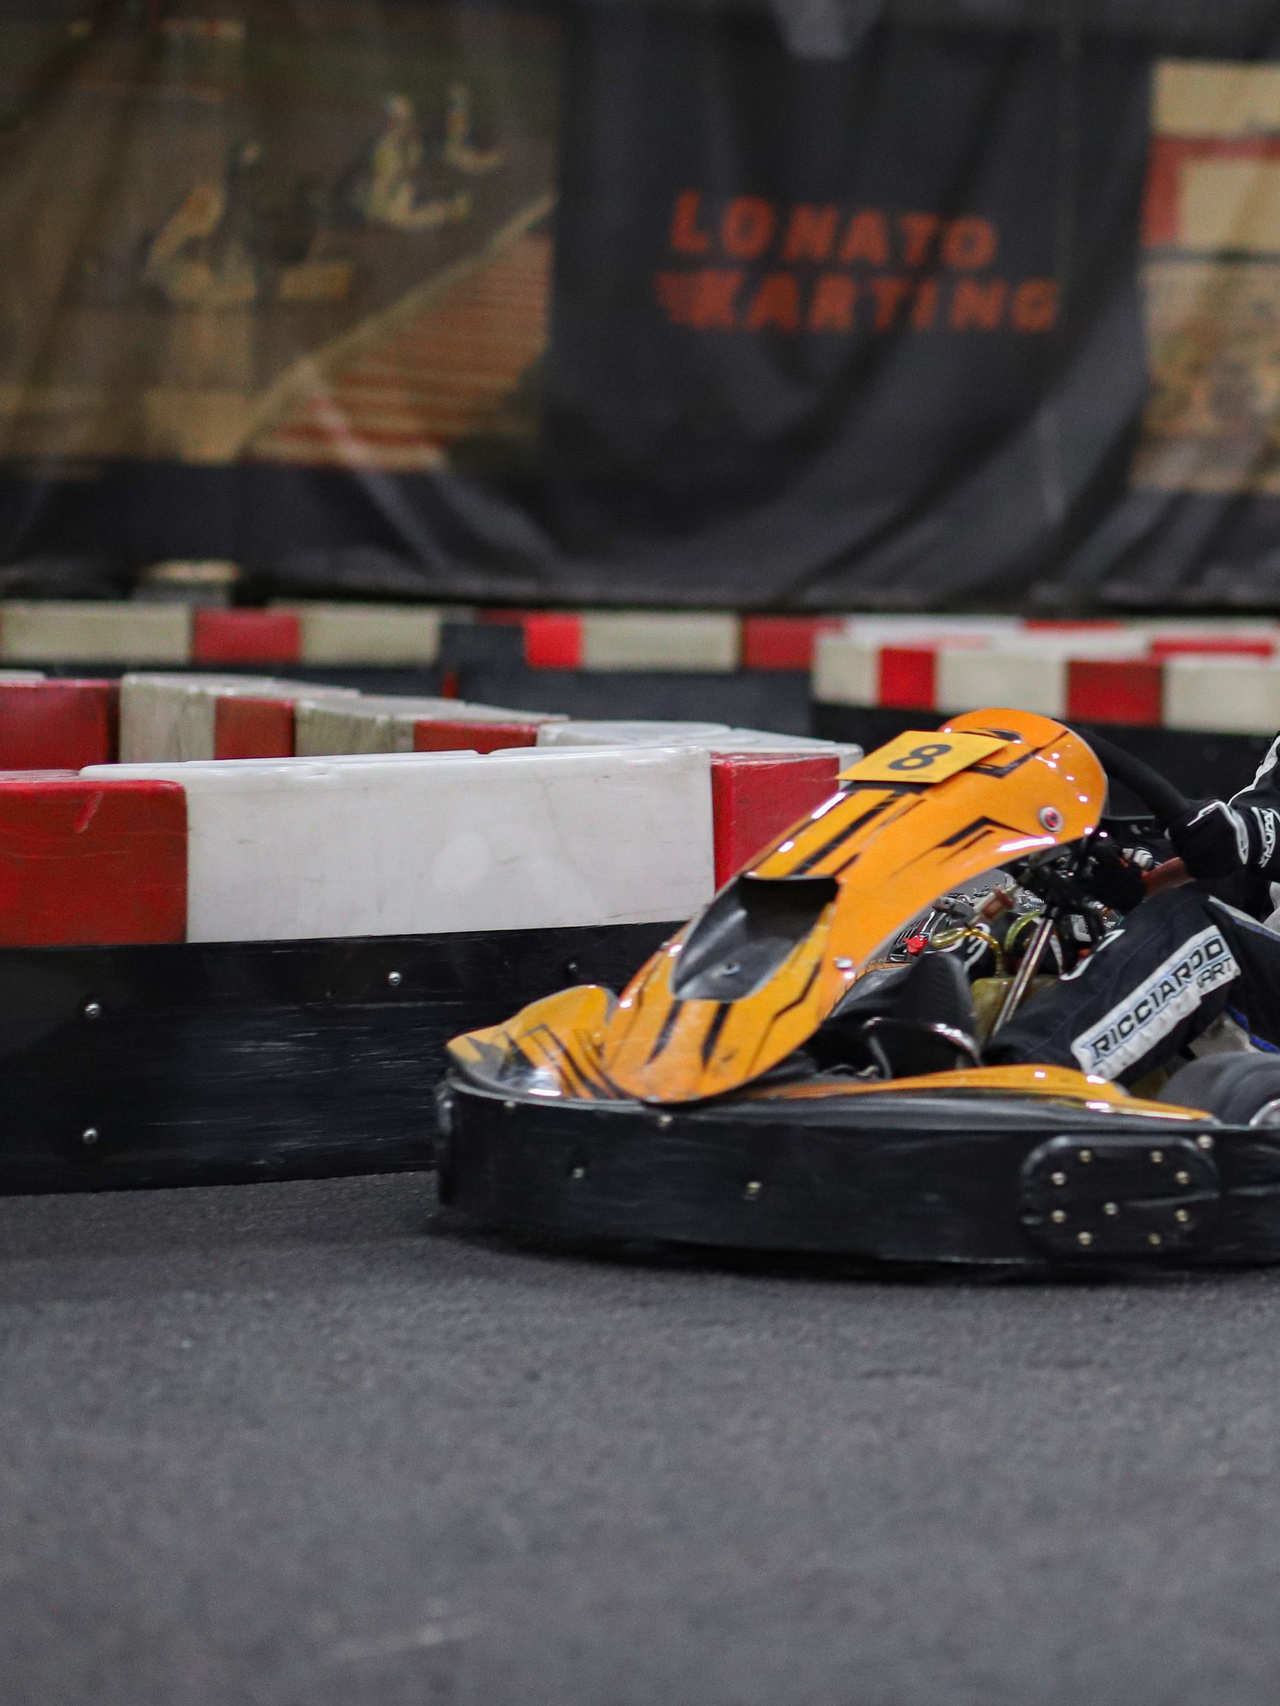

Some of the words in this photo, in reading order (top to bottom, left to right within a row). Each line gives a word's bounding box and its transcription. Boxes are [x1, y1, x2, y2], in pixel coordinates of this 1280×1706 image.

[669, 187, 997, 270] LONATO
[656, 269, 1060, 334] KARTING
[888, 743, 953, 771] 8
[1090, 937, 1224, 1059] RICCIARDO
